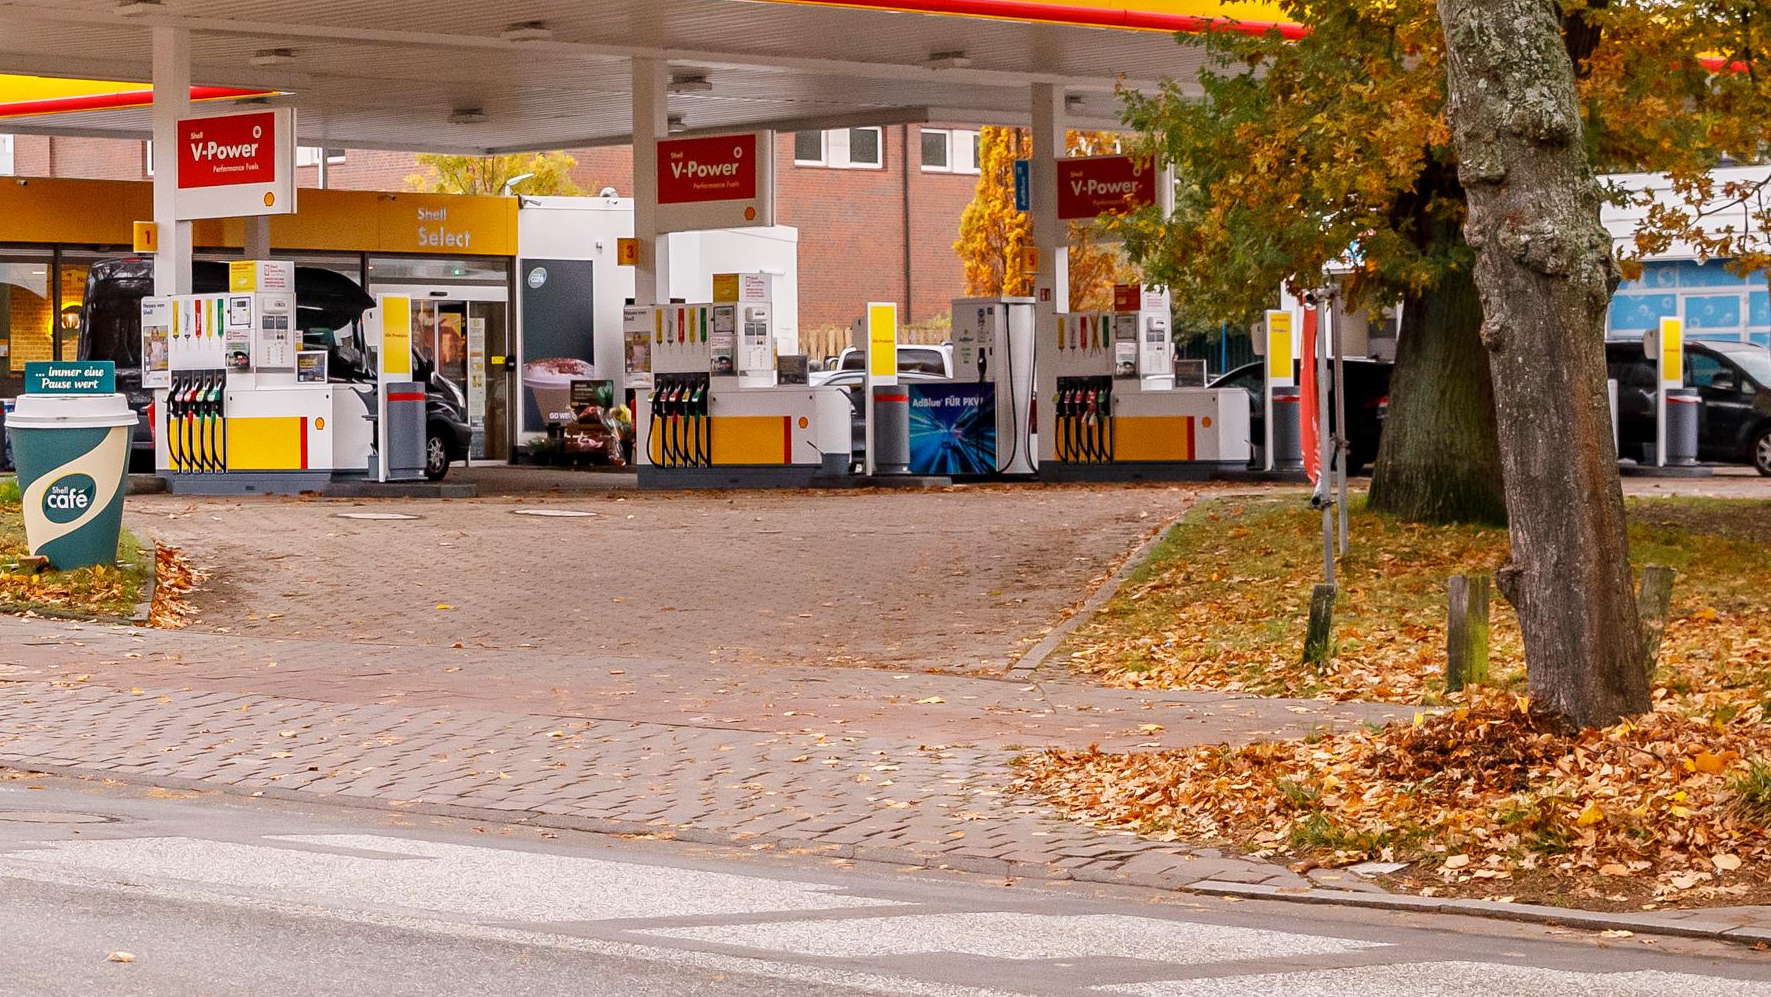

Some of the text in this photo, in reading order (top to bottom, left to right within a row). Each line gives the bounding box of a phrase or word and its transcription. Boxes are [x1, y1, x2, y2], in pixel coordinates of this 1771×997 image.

[190, 131, 204, 140] Shell
[190, 141, 259, 162] V-Power
[670, 151, 684, 159] Shell
[212, 162, 259, 173] Performance Fuels
[671, 161, 739, 179] V-Power
[1071, 179, 1139, 196] V-Power
[418, 207, 446, 221] Shell
[145, 230, 151, 245] 1
[419, 226, 470, 248] Select
[627, 245, 634, 258] 3
[48, 366, 82, 377] immer
[84, 366, 104, 377] eine
[41, 378, 99, 389] Pause wert
[944, 395, 961, 407] FÜR
[52, 486, 69, 494] Shell
[47, 487, 88, 509] café
